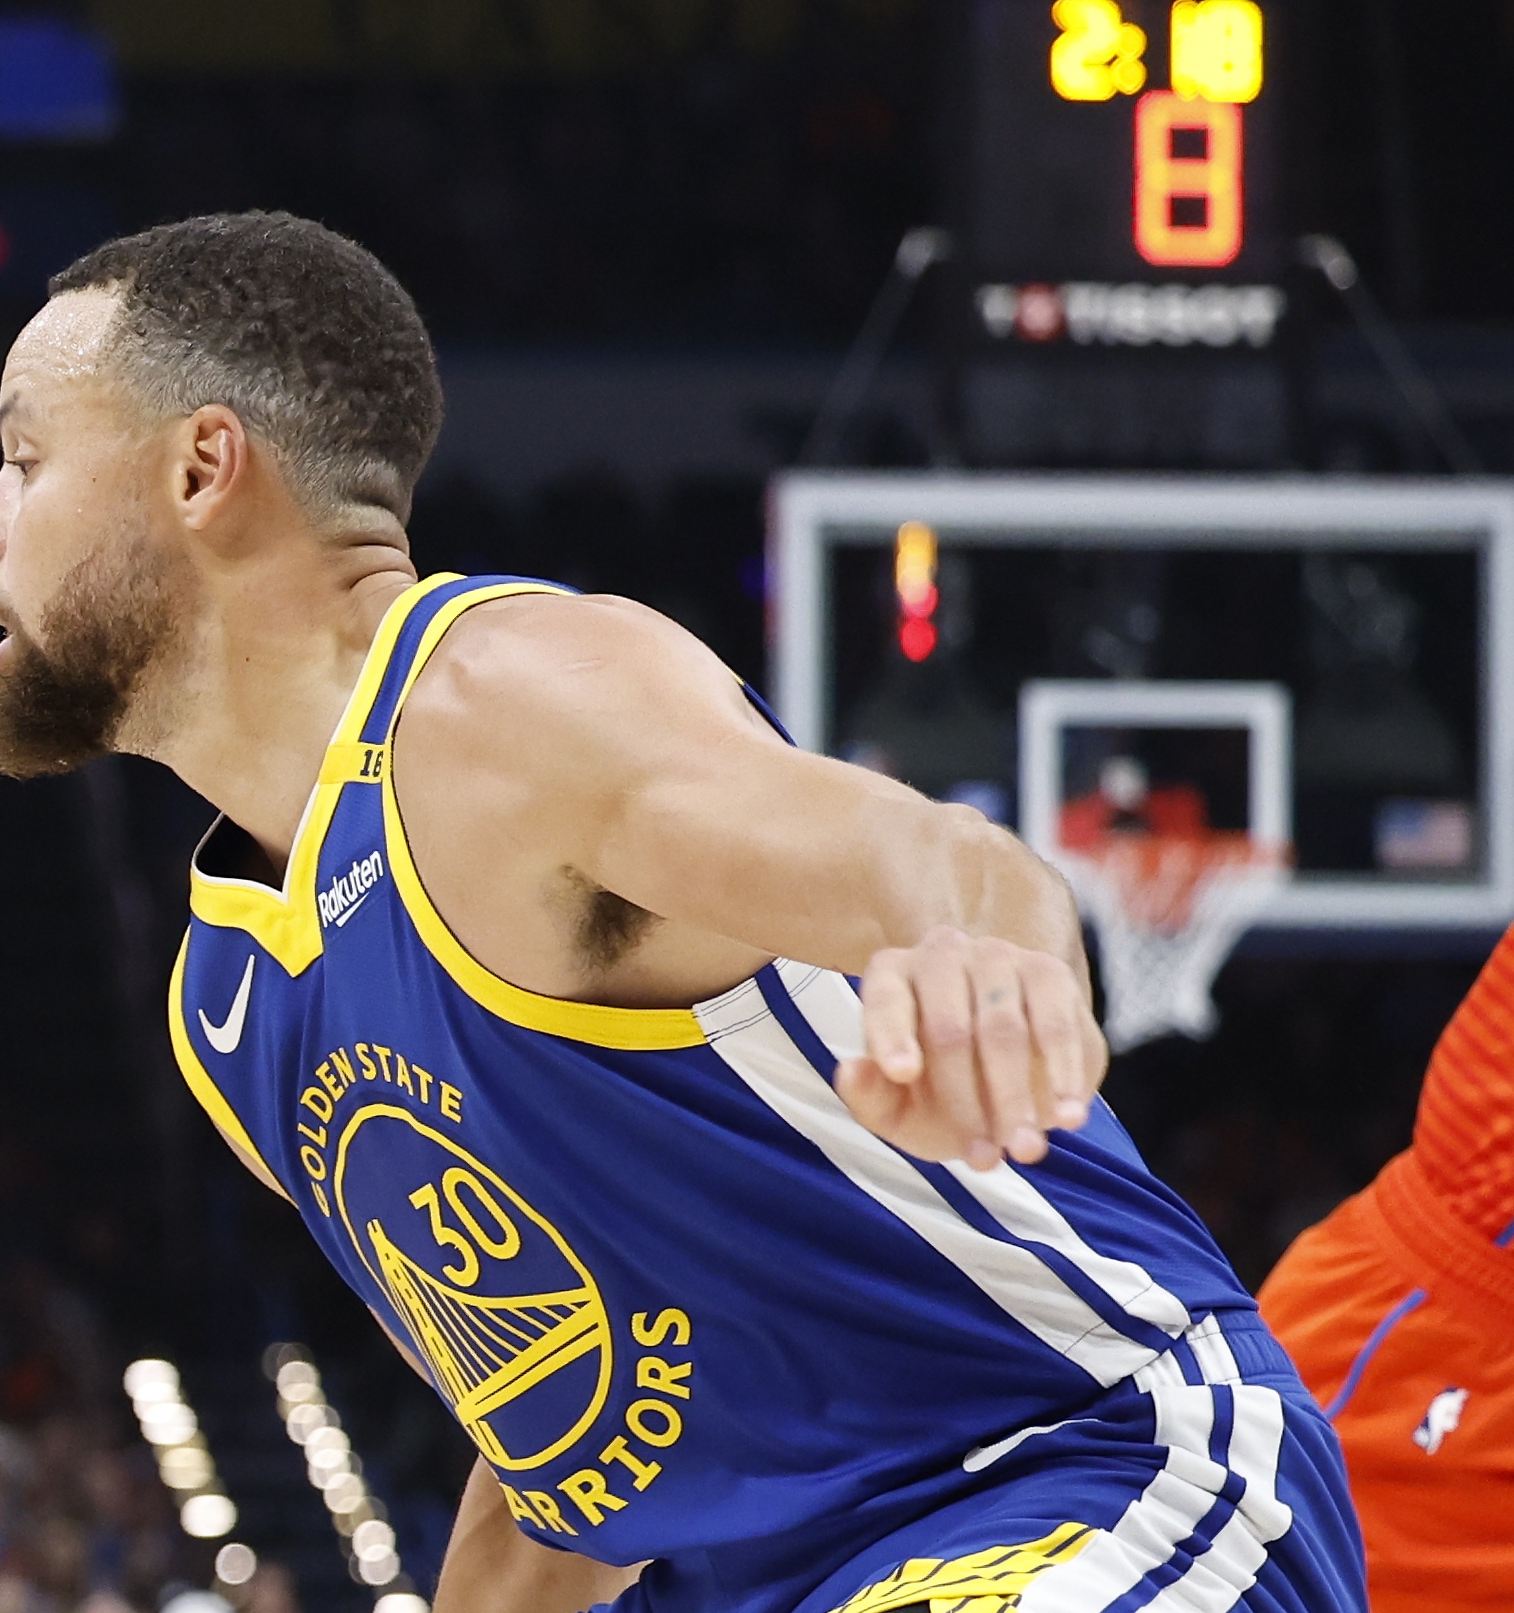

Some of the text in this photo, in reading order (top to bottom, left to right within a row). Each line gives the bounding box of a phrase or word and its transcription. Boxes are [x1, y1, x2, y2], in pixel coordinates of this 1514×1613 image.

[1133, 90, 1244, 267] 8
[318, 851, 384, 928] Rakuten
[297, 1042, 464, 1218] GOLDEN STATE
[408, 1166, 521, 1288] 30
[499, 1307, 693, 1536] ARRIORS
